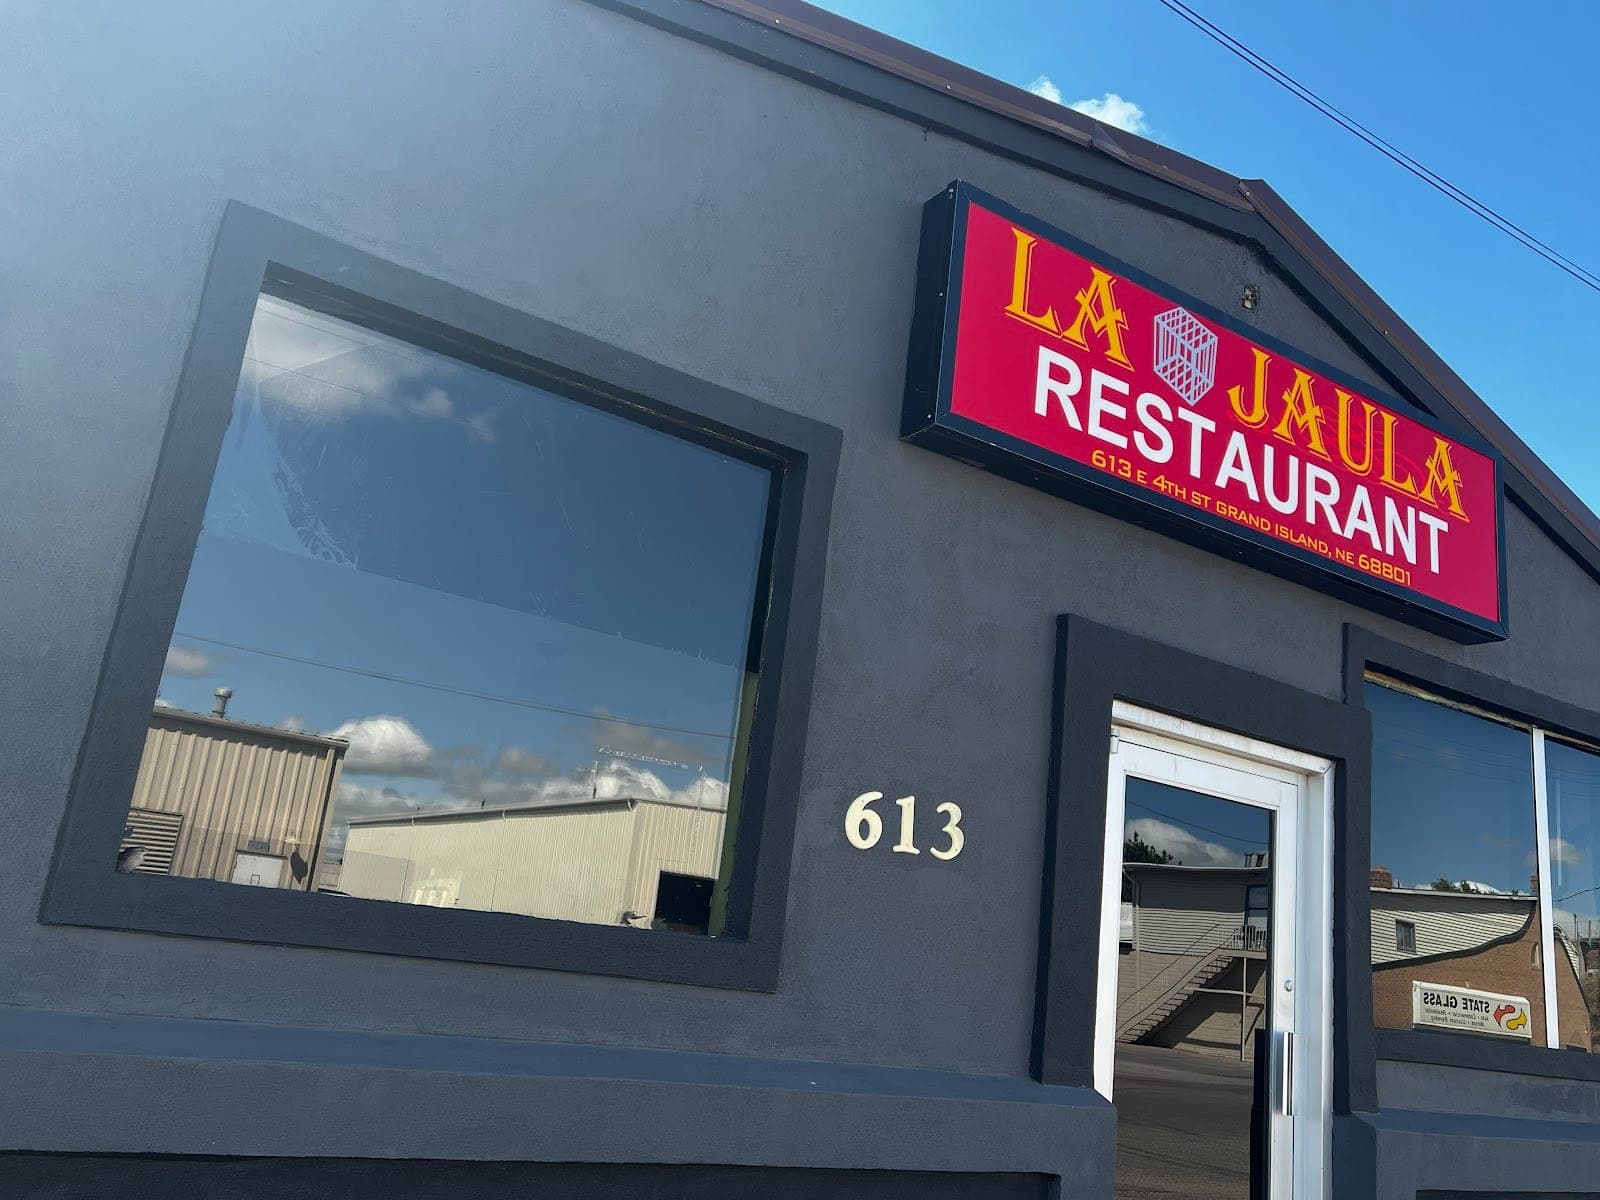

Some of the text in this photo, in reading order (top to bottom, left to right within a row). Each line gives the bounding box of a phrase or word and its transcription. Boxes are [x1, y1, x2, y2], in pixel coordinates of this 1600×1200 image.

[1005, 227, 1470, 522] LA JAULA
[1034, 345, 1449, 573] RESTAURANT
[1091, 450, 1411, 585] 613 E 4TH ST GRAND ISLAND, NE 68801
[844, 790, 965, 862] 613
